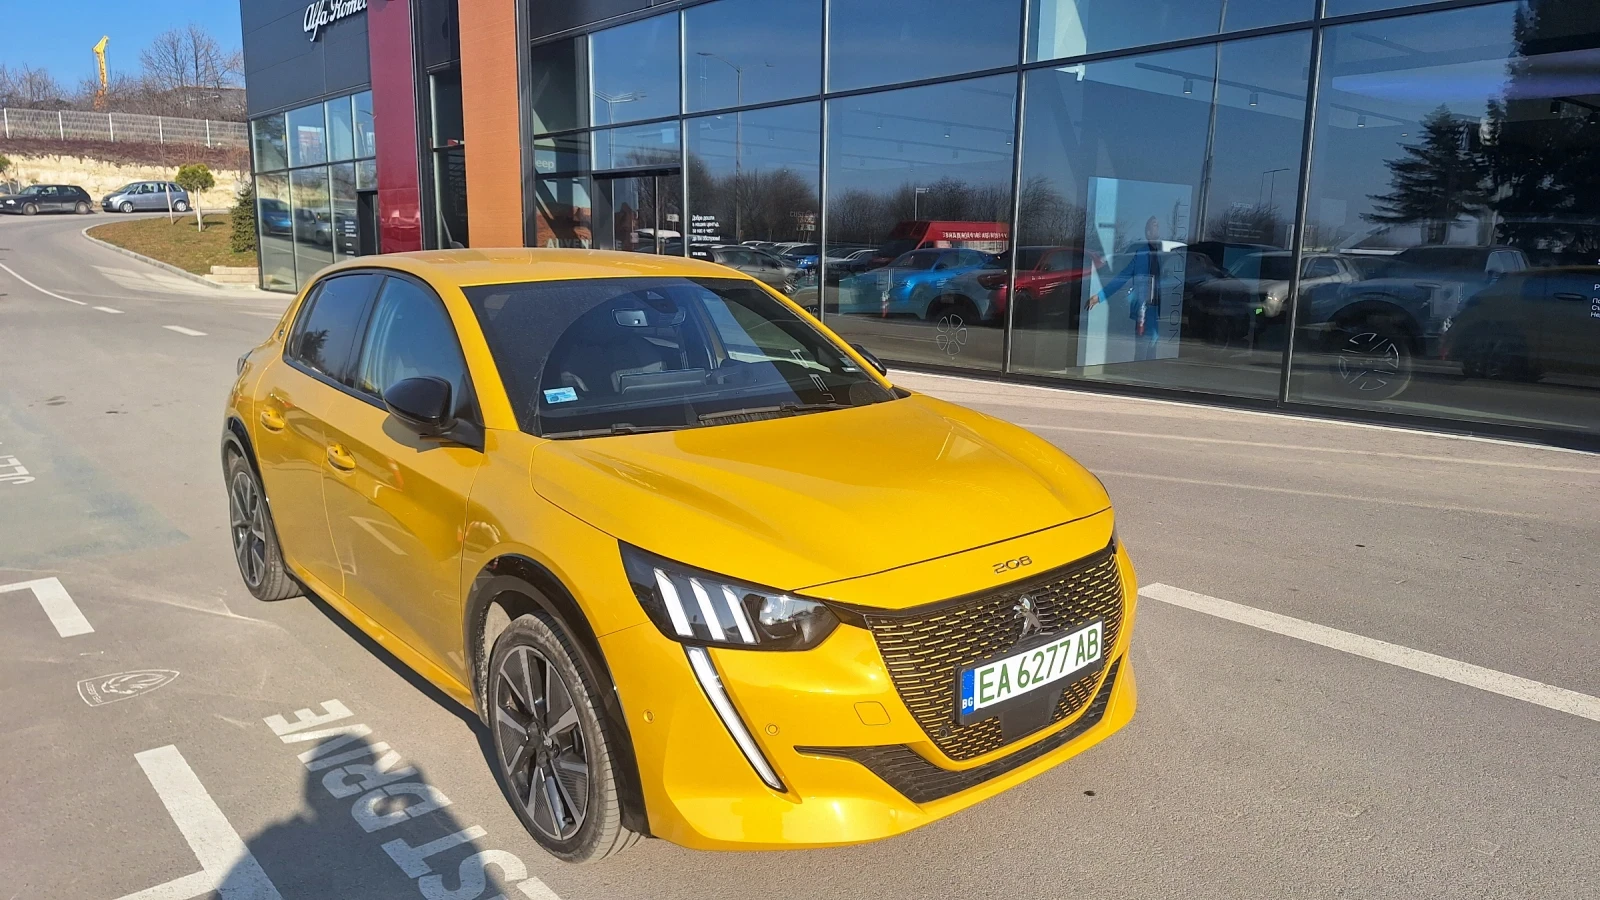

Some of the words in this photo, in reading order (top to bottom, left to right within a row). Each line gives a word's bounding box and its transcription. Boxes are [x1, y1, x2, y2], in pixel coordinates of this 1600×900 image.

[303, 0, 329, 42] Alfa
[536, 160, 555, 170] eep
[992, 555, 1033, 575] 208
[979, 663, 1012, 704] EA
[1017, 639, 1071, 689] 6277
[1075, 628, 1099, 667] AB
[962, 696, 974, 710] BG
[262, 698, 453, 833] DRIVE
